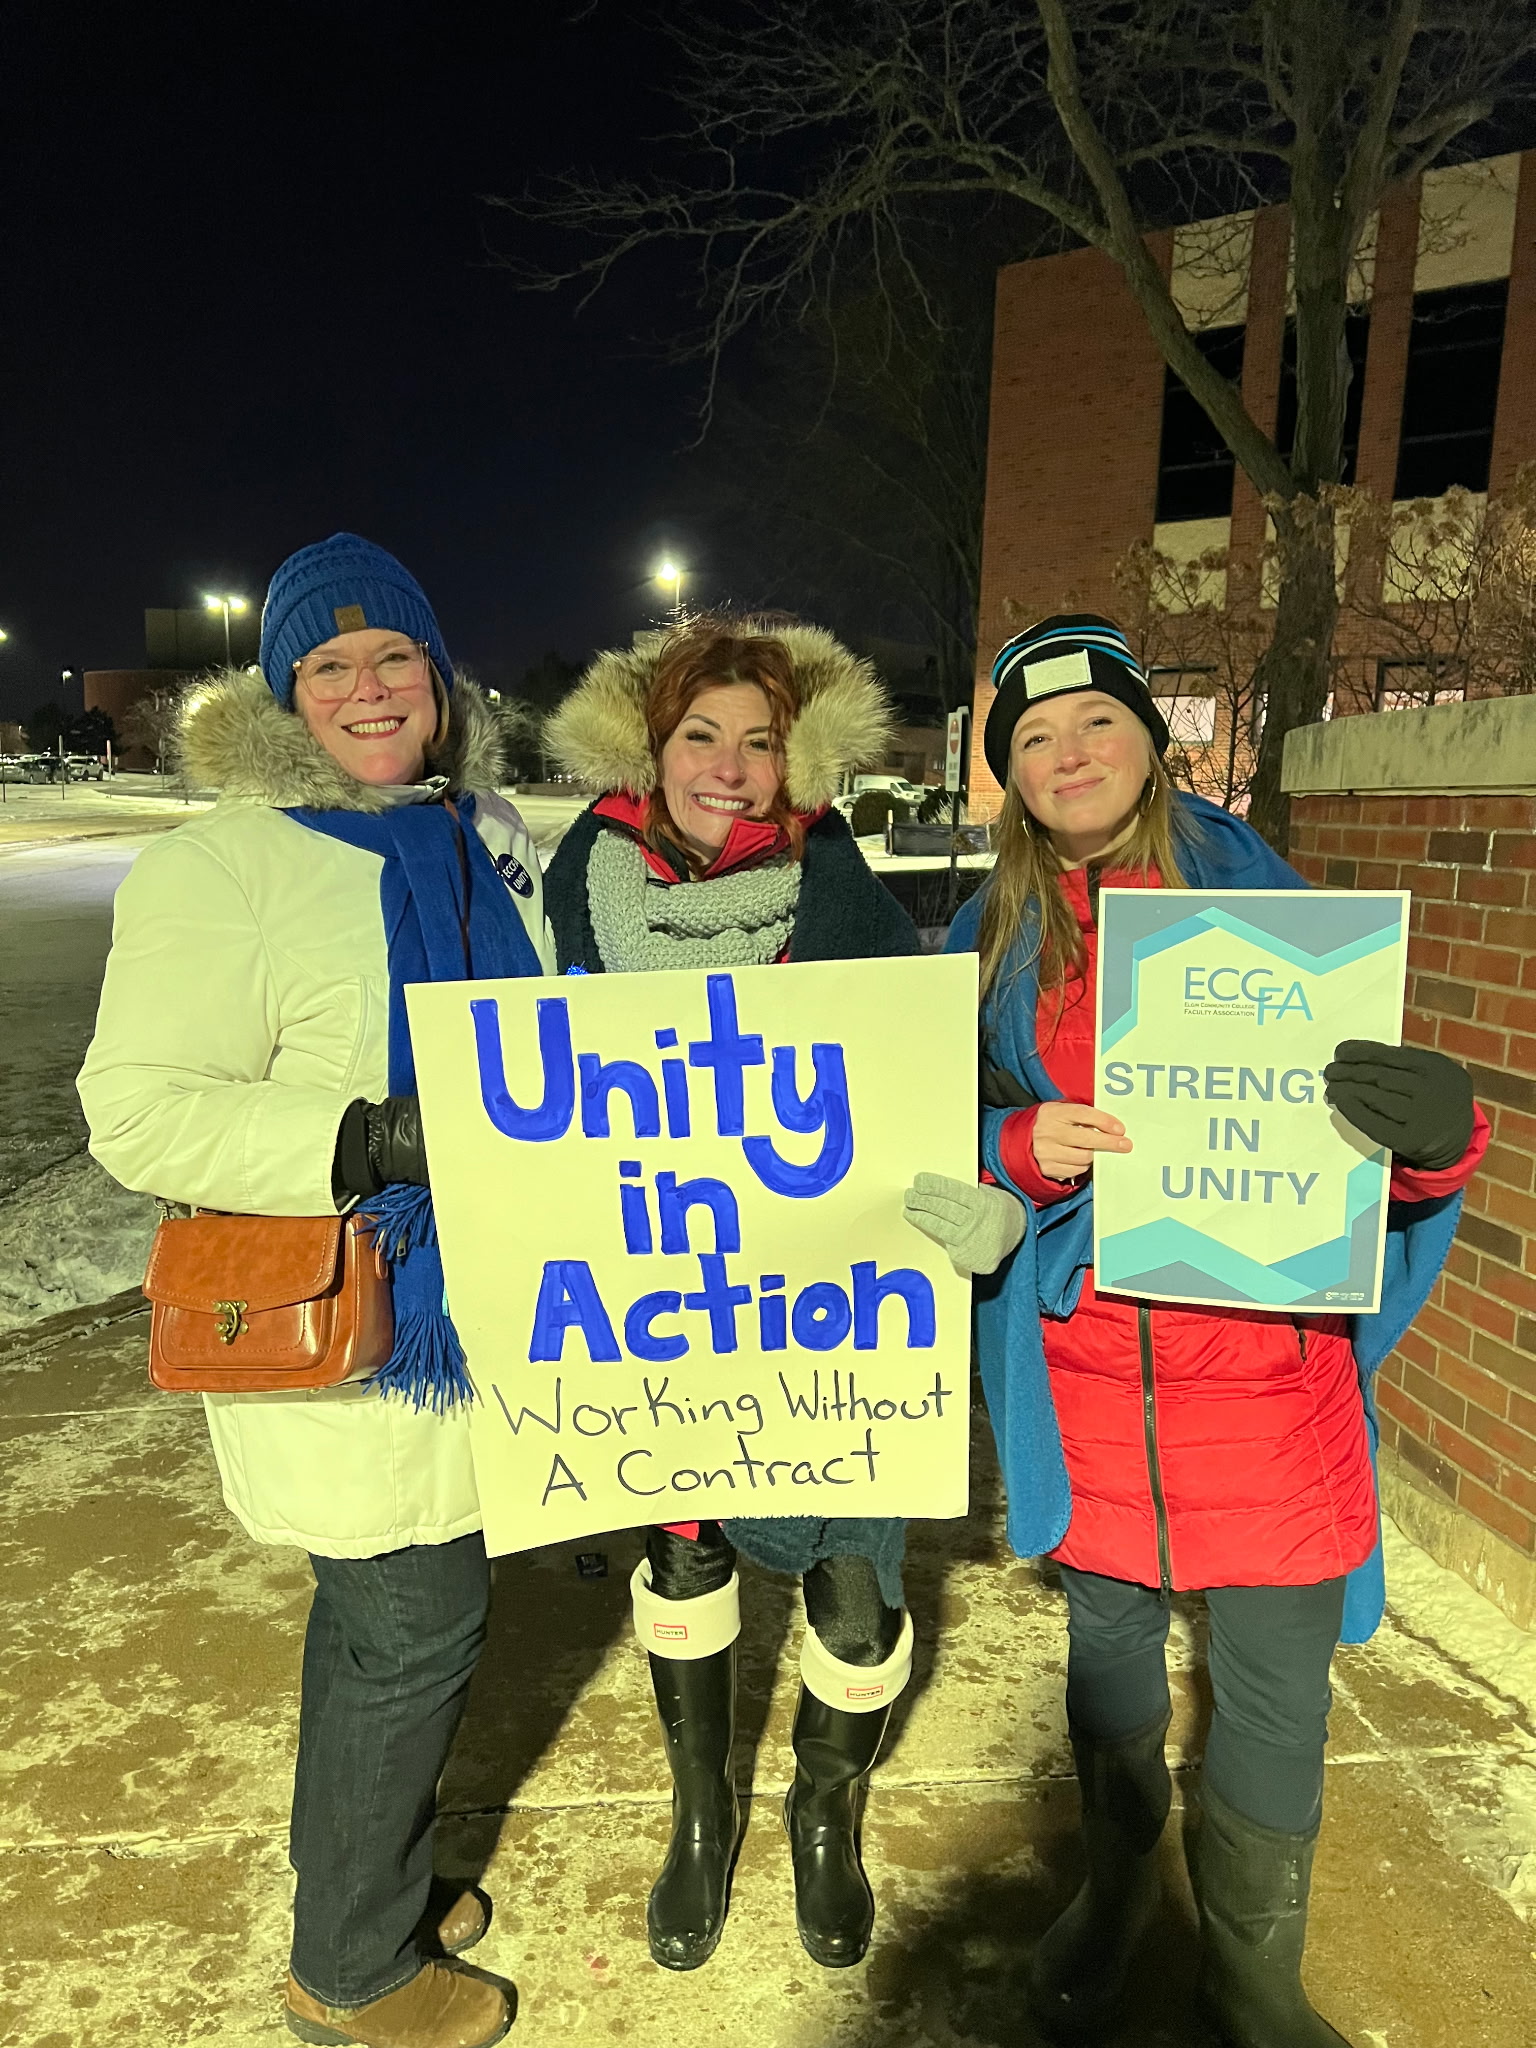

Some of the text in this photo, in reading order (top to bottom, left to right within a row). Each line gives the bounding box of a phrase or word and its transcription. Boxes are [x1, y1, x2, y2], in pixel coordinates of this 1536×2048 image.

[470, 973, 854, 1198] Unity
[1104, 1061, 1324, 1105] STRENG
[1208, 1117, 1260, 1153] IN
[619, 1160, 741, 1255] in
[1161, 1166, 1320, 1206] UNITY
[528, 1253, 936, 1363] Action
[778, 1369, 953, 1423] Without
[541, 1429, 881, 1506] A Contract
